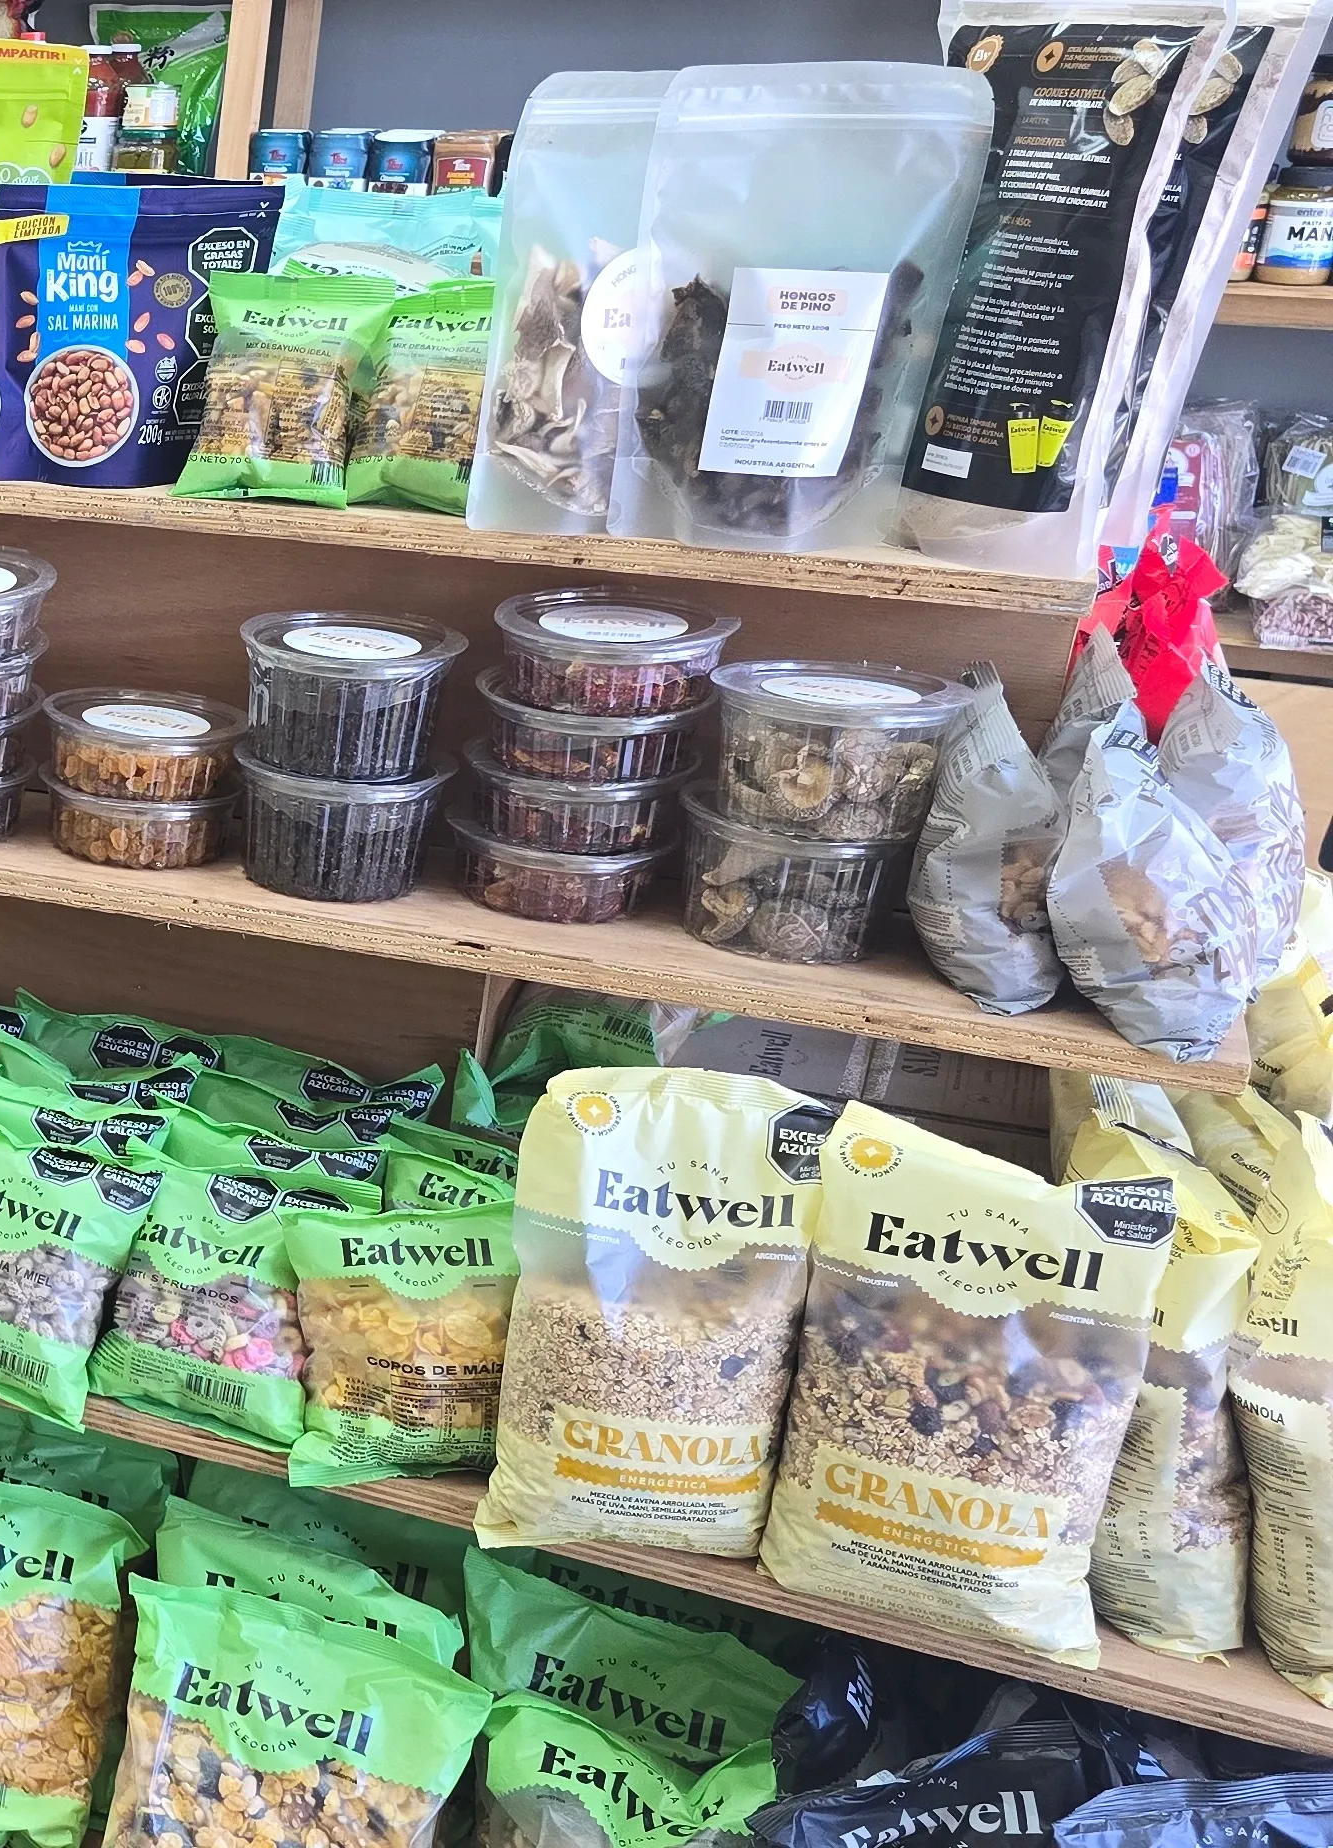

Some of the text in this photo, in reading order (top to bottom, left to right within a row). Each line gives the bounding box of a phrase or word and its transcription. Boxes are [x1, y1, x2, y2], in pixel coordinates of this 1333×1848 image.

[1033, 87, 1106, 100] COOKIES EATWELL
[13, 225, 62, 239] LIMITADA
[15, 215, 56, 230] EDICIÓN
[197, 240, 251, 251] EXCESO EN
[203, 250, 244, 260] GRASAS
[57, 250, 111, 272] Maní
[201, 260, 243, 270] TOTALES
[779, 290, 837, 302] HONGOS
[781, 302, 832, 312] DE PINO
[47, 313, 119, 332] SAL MARINA
[242, 309, 349, 332] Eatwell
[773, 322, 791, 330] PESO
[262, 344, 332, 358] DESAYUNO IDEAL
[767, 360, 825, 375] Eatwell
[137, 424, 163, 446] 200g
[733, 458, 815, 469] INDUSTRIA ARGENTINA
[593, 1168, 795, 1229] Eatwell
[947, 1208, 1030, 1236] TU SANA
[1113, 1220, 1158, 1235] Ministerio
[651, 1224, 722, 1250] ELECCIÓN
[1113, 1228, 1152, 1242] de Salud
[339, 1237, 495, 1268] Eatwell
[863, 1210, 1105, 1293] Eatwell
[13, 1264, 23, 1276] Y
[24, 1268, 53, 1288] MIEL
[937, 1268, 1019, 1295] ELECCIÓN
[162, 1274, 239, 1304] FRUTADOS
[367, 1356, 427, 1376] COPOS
[433, 1364, 457, 1376] DE
[563, 1420, 762, 1467] GRANOLA
[619, 1474, 708, 1491] ENERGÉTICA
[824, 1462, 1050, 1539] GRANOLA
[883, 1524, 981, 1558] ENERGÉTICA
[850, 1539, 981, 1580] MEZCLA DE AVENA ARROLLADA,
[865, 1560, 992, 1595] ARANDANOS DESHIDRATADOS
[959, 1575, 1019, 1588] FRUTOS SECOS
[173, 1662, 375, 1758] Eatwell
[526, 1651, 727, 1758] Eatwell
